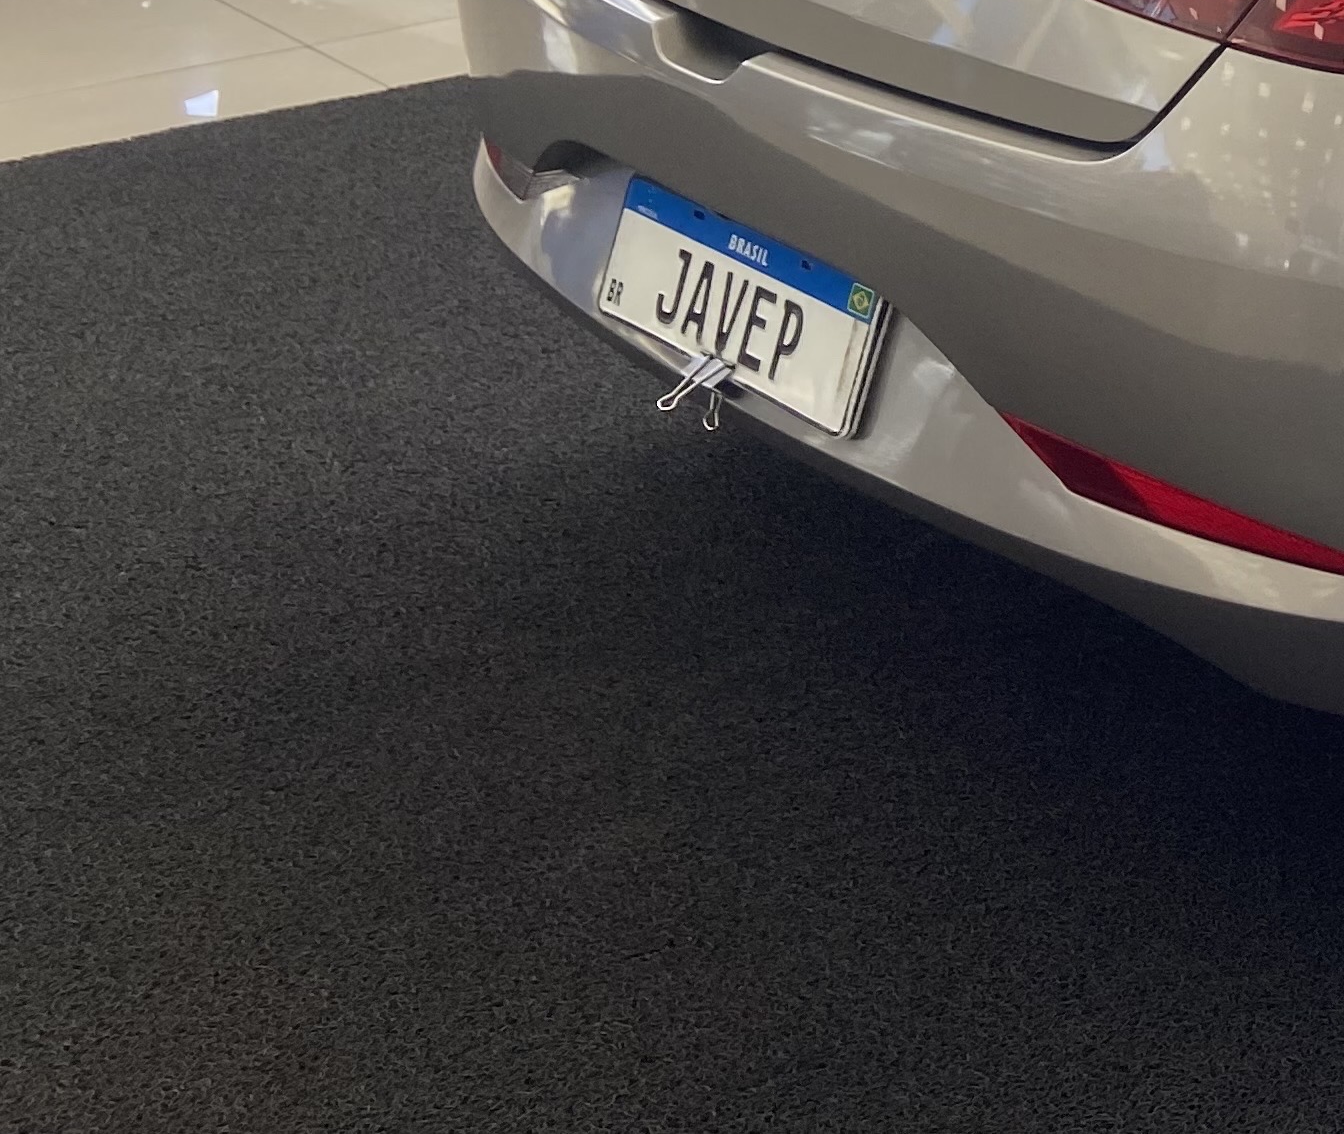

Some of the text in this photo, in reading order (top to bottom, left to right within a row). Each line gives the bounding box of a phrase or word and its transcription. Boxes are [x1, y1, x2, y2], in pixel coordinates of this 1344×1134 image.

[726, 233, 770, 267] BRASIL
[606, 278, 625, 307] BR
[655, 248, 804, 381] JAVEP
